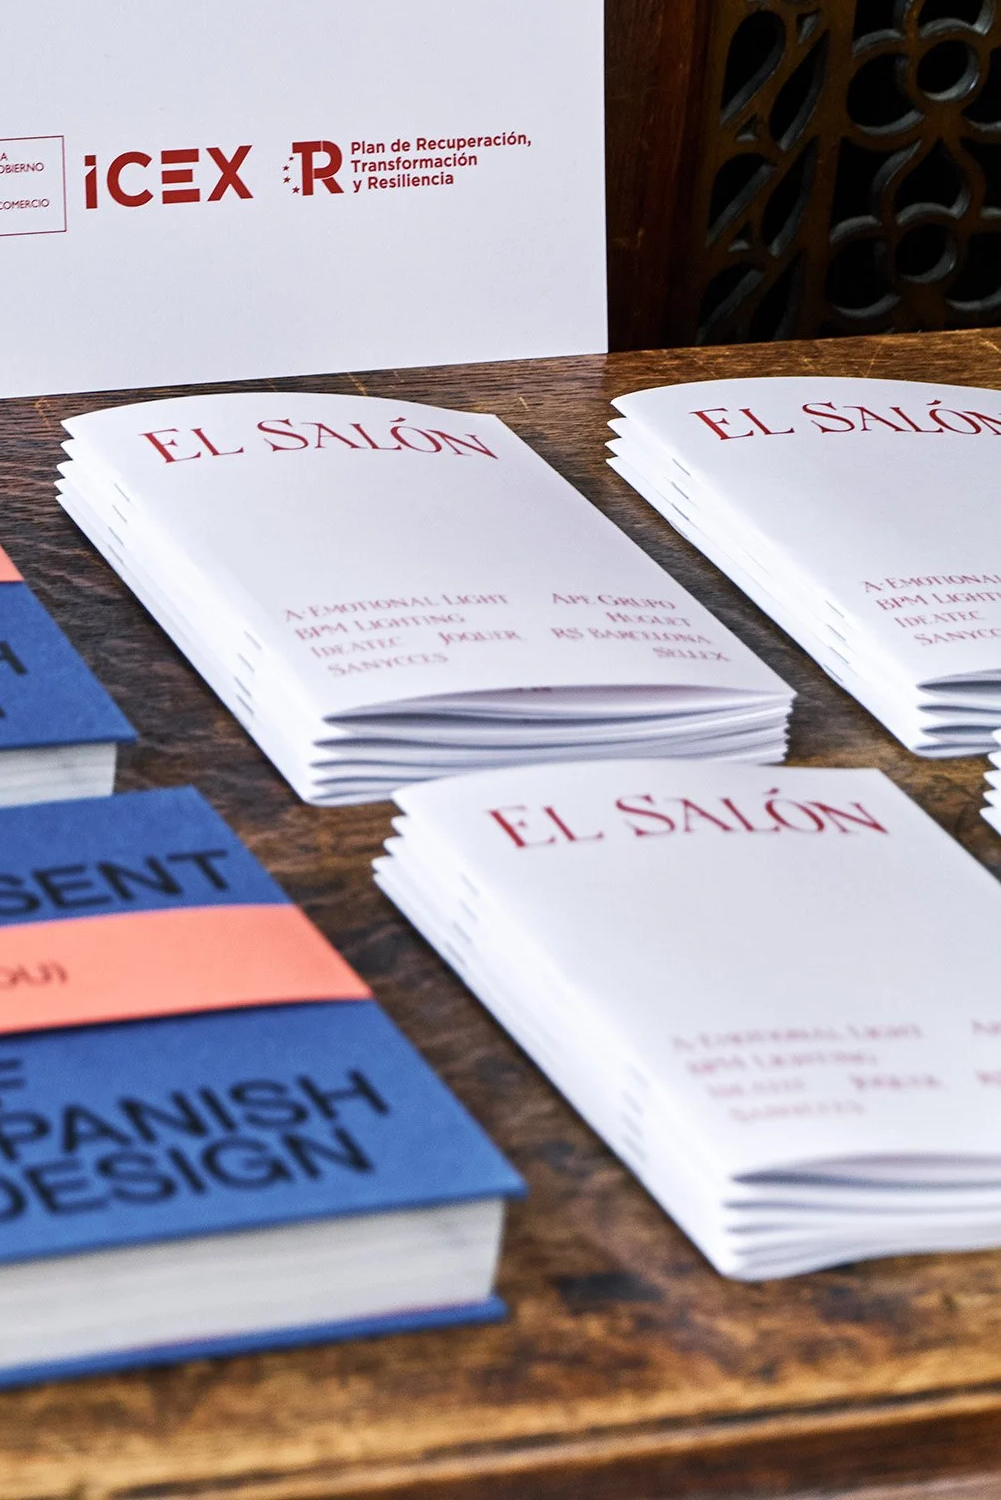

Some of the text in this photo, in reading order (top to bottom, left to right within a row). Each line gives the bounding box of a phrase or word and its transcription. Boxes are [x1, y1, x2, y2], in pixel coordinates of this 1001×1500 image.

[351, 132, 532, 156] Plan de Recuperación,
[351, 153, 477, 173] Transformación
[353, 171, 454, 193] y Resiliencia
[689, 408, 795, 440] EL
[140, 417, 499, 464] EL SALÓN
[486, 788, 889, 849] EL SALÓN
